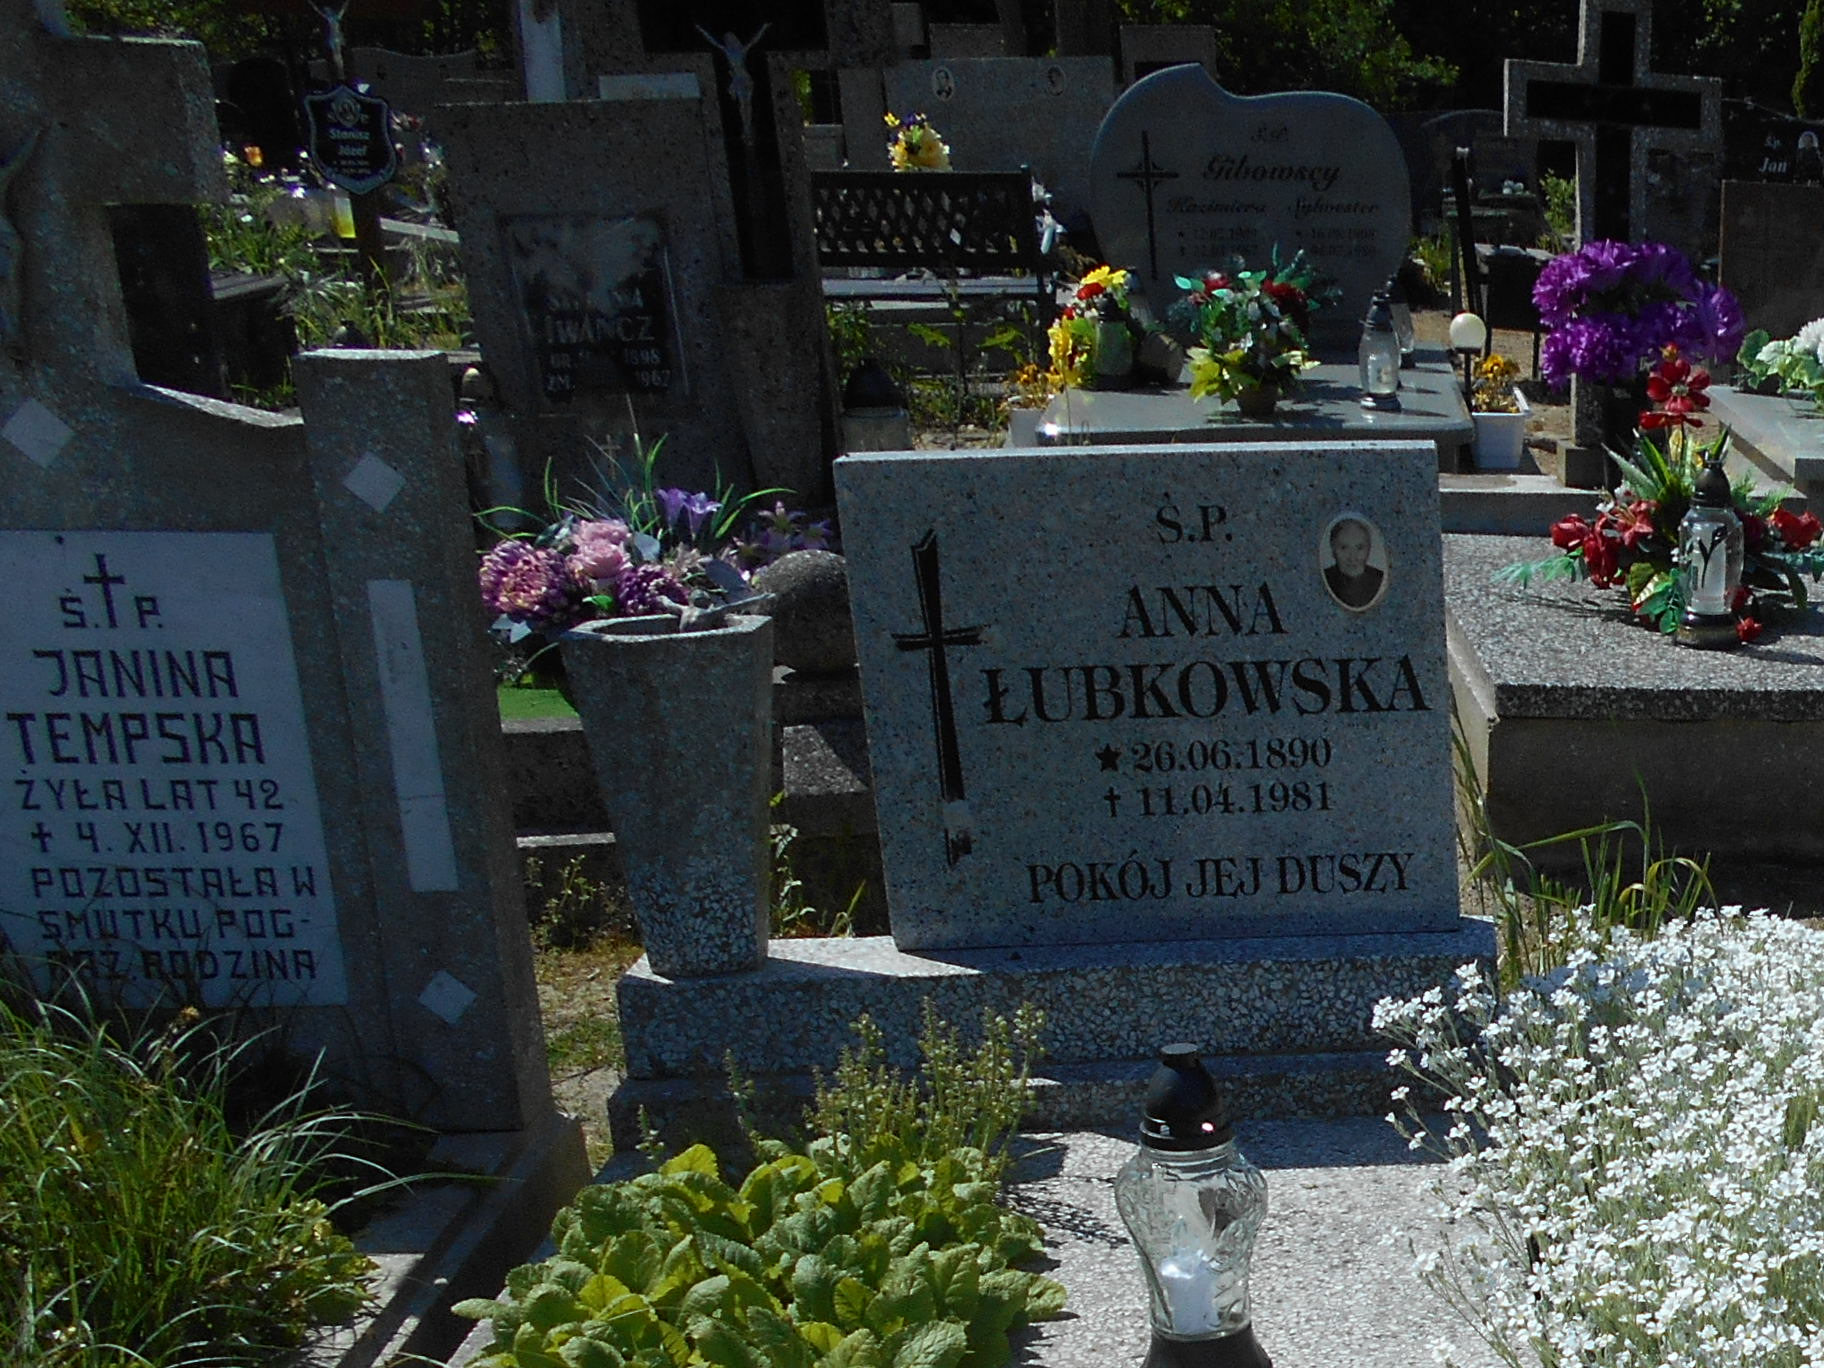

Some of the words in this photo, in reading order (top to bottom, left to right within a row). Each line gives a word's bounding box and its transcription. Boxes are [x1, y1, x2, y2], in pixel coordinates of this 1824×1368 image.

[1758, 156, 1788, 174] Jan
[1117, 580, 1289, 639] ANNA
[33, 649, 239, 698] JANINA
[979, 653, 1433, 728] ŁUBKOWSKA
[6, 711, 266, 764] TEMPSKA
[1132, 736, 1332, 773] 26.06.1890
[14, 769, 127, 810] ŻYŁA
[140, 778, 219, 810] LAT
[233, 778, 284, 810] 42
[1138, 781, 1335, 818] 11.04.1981
[123, 821, 186, 854] XII.
[197, 821, 284, 853] 1967
[31, 867, 280, 898] POZOSTAŁA
[291, 865, 317, 896] W
[1027, 849, 1173, 904] POKÓJ
[1186, 856, 1261, 899] JEJ
[1276, 852, 1415, 895] DUSZY
[38, 908, 200, 940] SMUTKU
[141, 949, 318, 982] RODZINA
